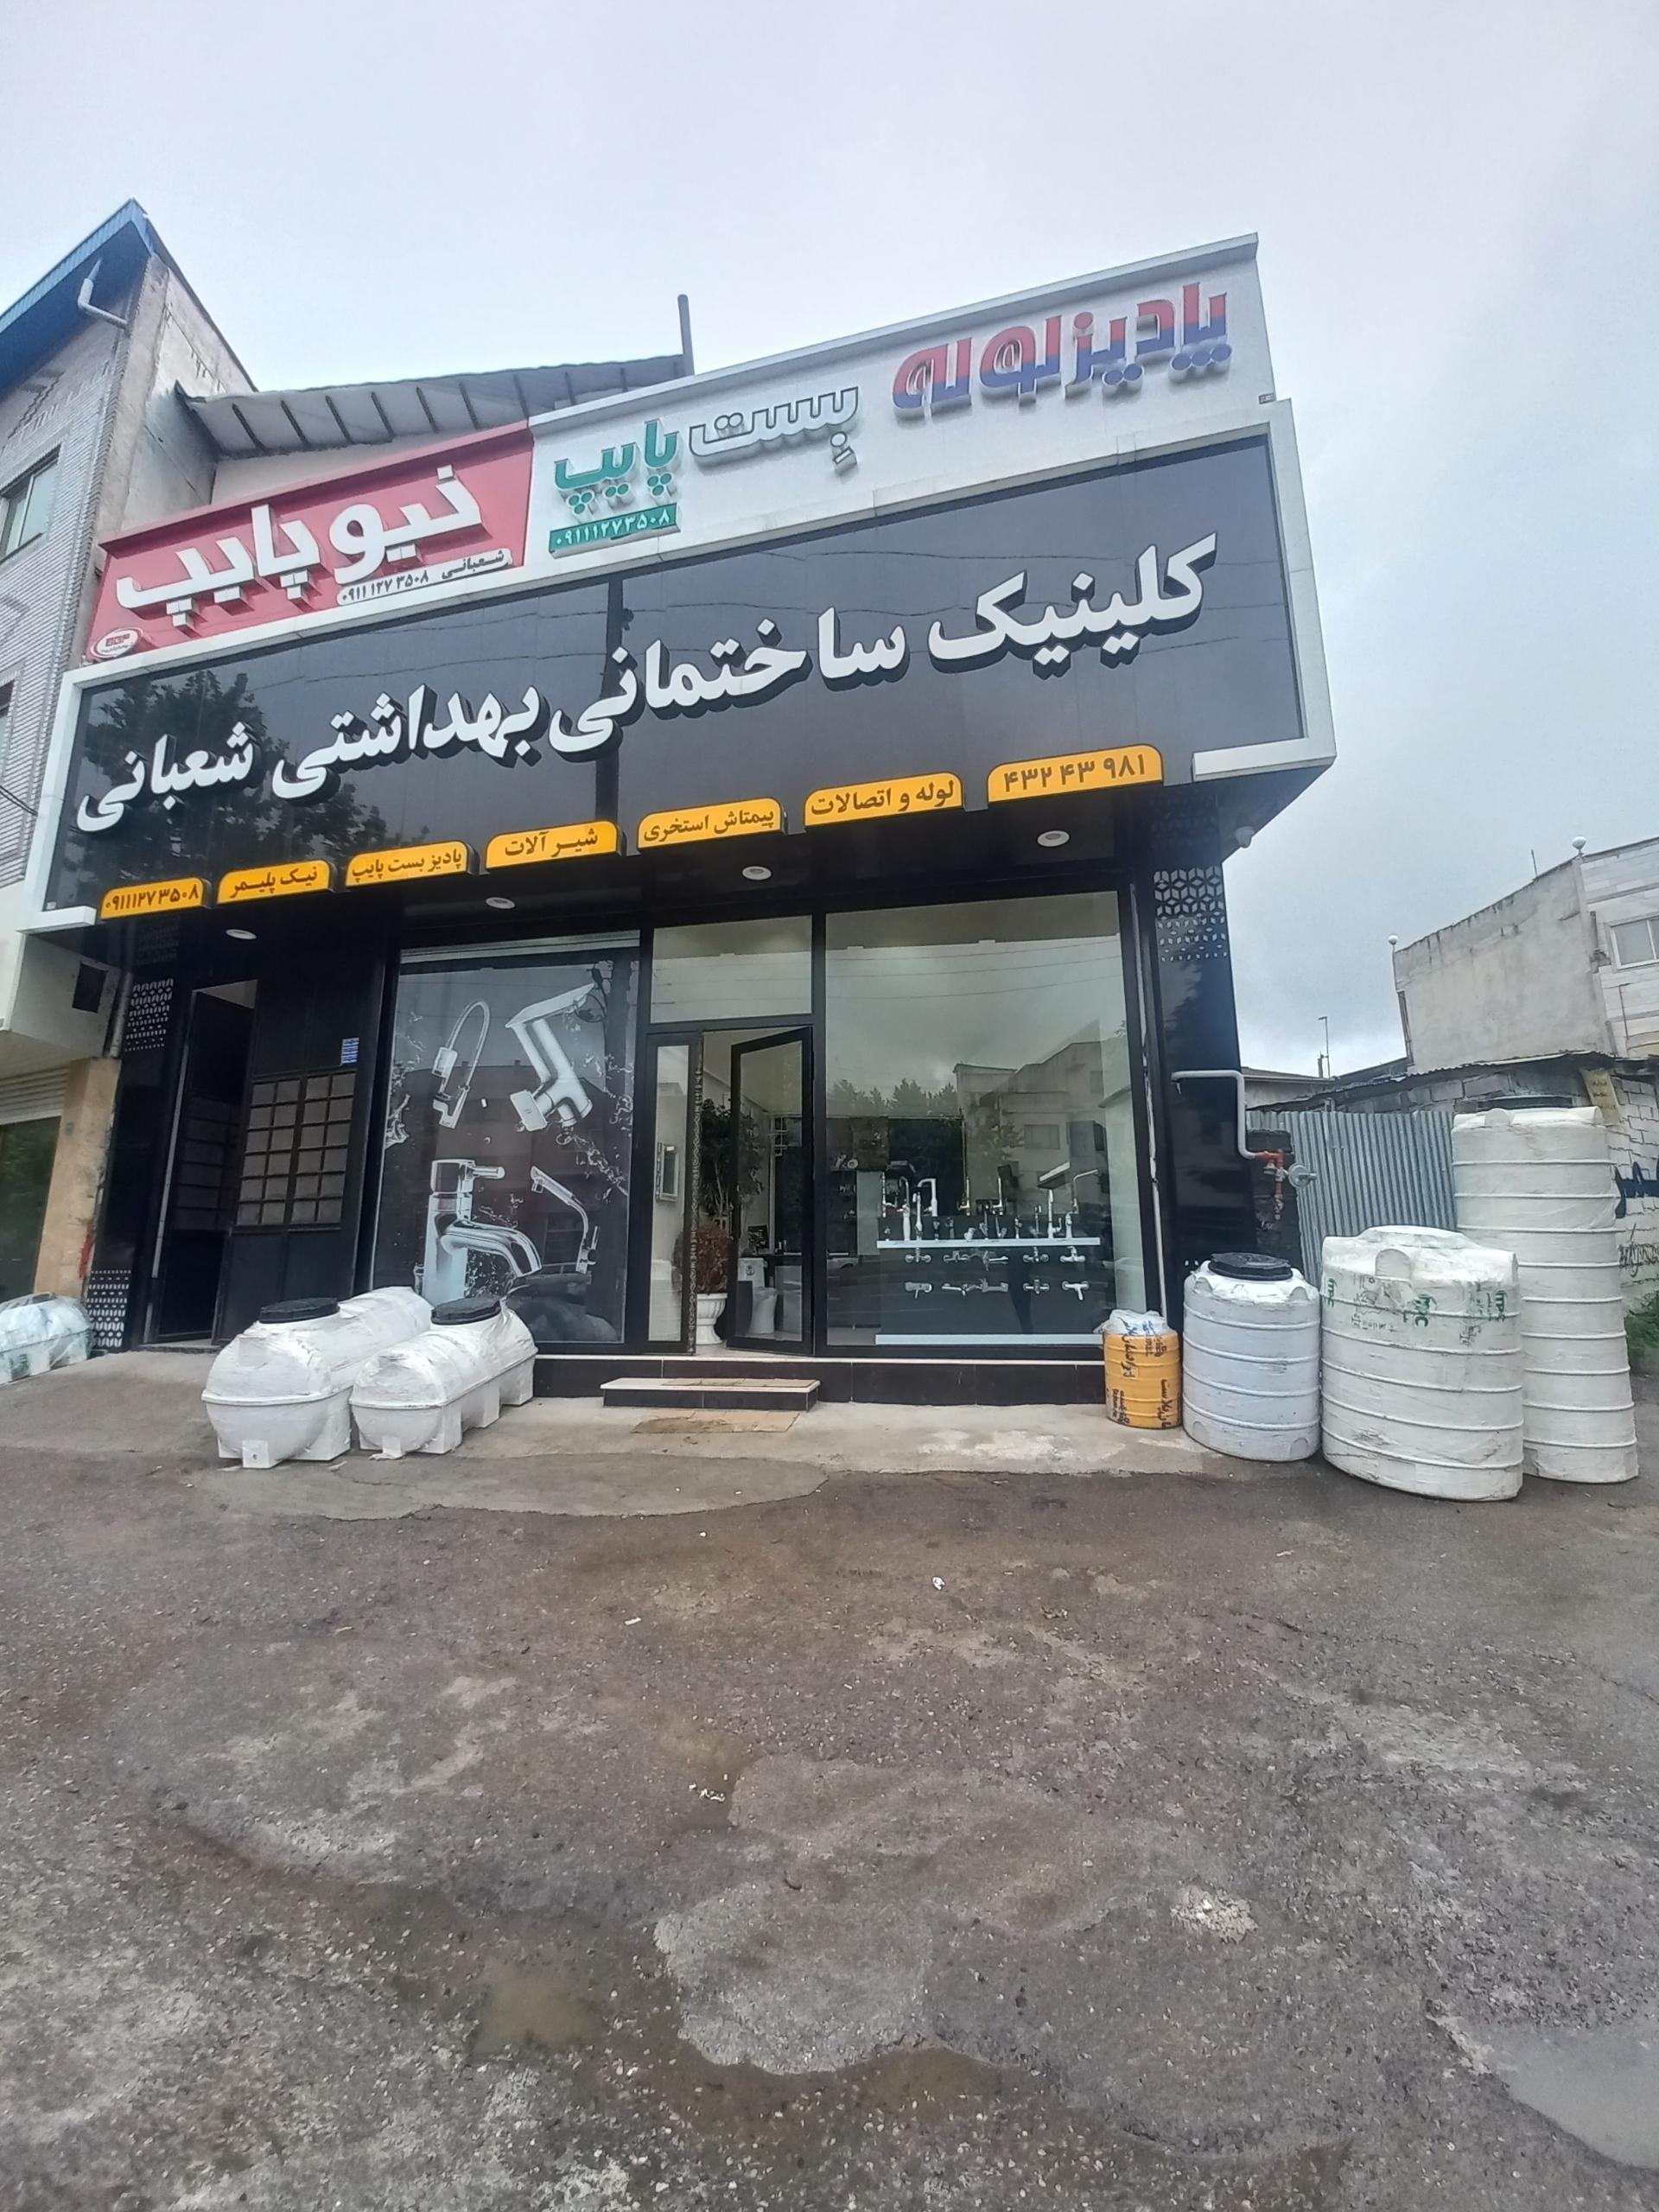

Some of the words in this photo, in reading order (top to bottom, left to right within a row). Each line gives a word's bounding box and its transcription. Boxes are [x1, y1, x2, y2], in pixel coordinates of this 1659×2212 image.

[1065, 283, 1233, 392] پادیز
[893, 315, 1063, 410] لوله
[554, 418, 680, 516] پایپ
[442, 550, 505, 580] شعبانی
[928, 532, 1217, 666] کلینیک
[548, 606, 907, 754] ساختمانی
[271, 684, 541, 800] بهداشتی
[76, 721, 255, 833] شعبانی
[810, 787, 892, 816] اتصالات
[898, 792, 910, 812] و
[916, 779, 954, 807] لوله
[644, 815, 709, 842] استخری
[352, 859, 385, 882] پایپ
[388, 856, 425, 873] بست
[431, 848, 462, 871] پادیز
[230, 870, 276, 899] پلیمر
[280, 866, 318, 887] نیک
